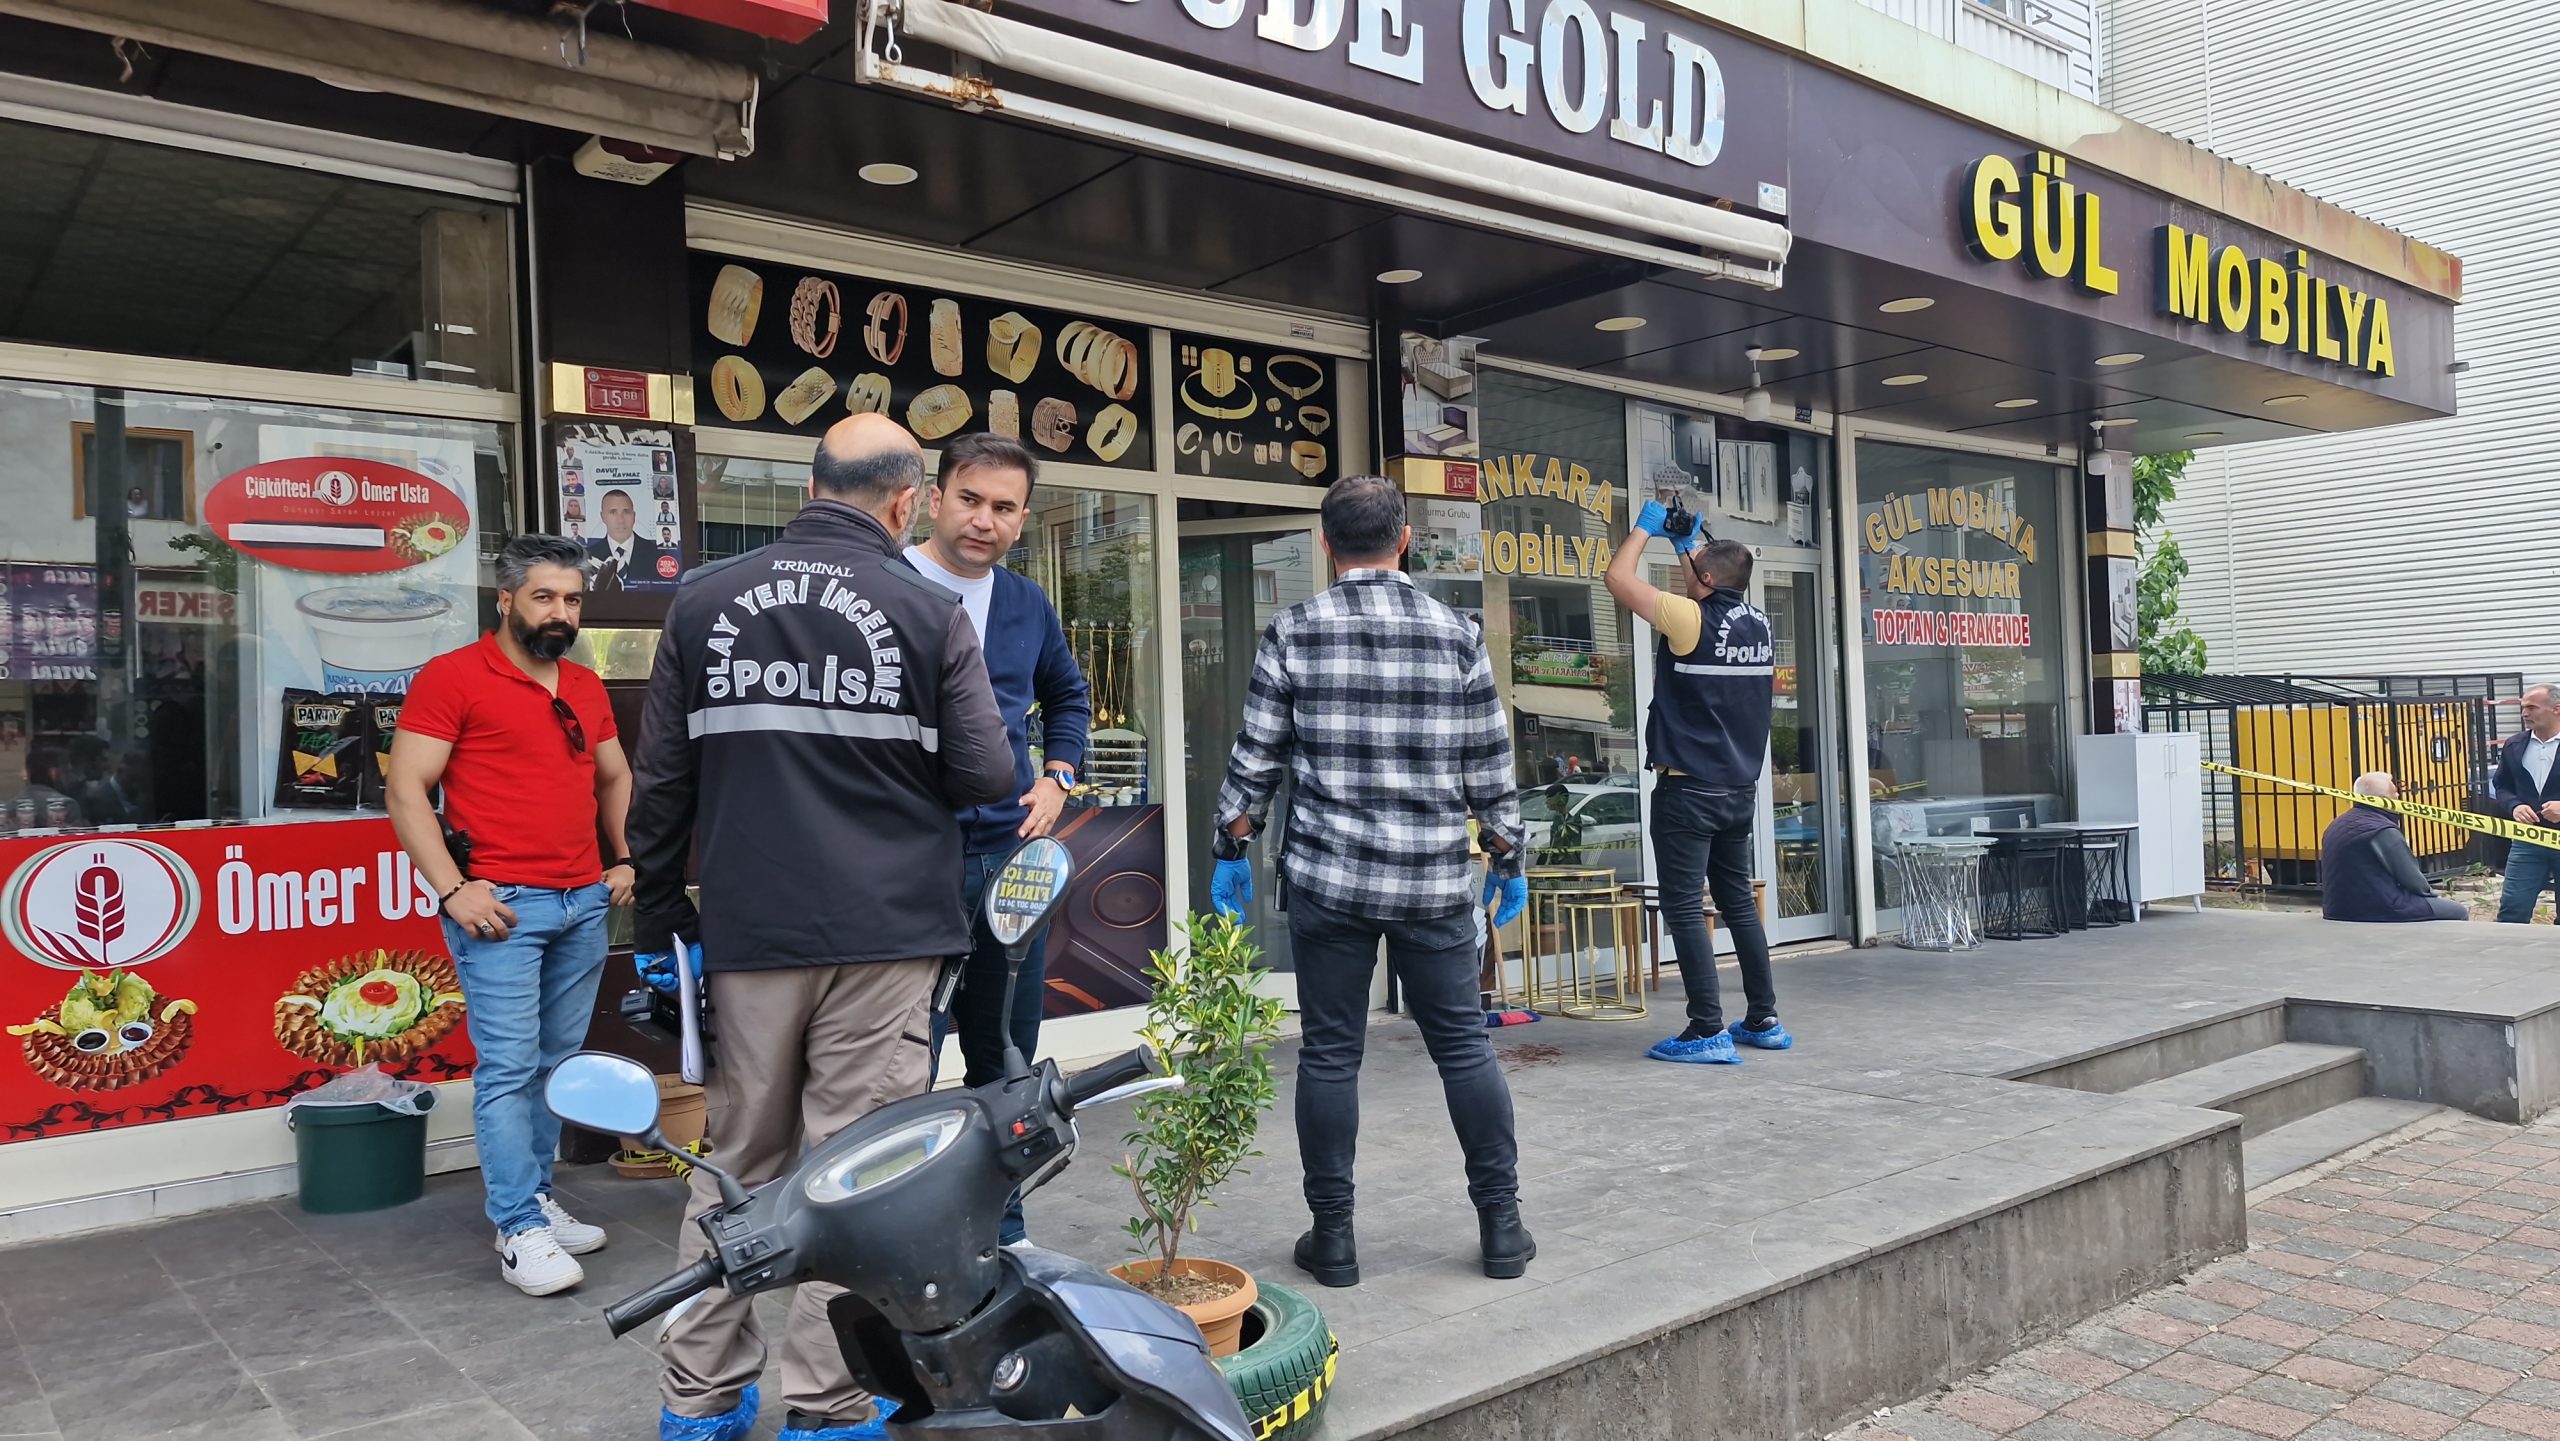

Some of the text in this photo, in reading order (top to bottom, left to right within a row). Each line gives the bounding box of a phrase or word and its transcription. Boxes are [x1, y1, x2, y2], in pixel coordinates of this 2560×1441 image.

[1462, 0, 1727, 167] GOLD
[1966, 150, 2396, 379] GÜL MOBİLYA
[245, 475, 311, 500] Çiğköfteci
[361, 475, 430, 504] Ömer Usta
[1447, 508, 1471, 519] Grubu
[1865, 485, 2035, 565] GÜL MOBİLYA
[1887, 554, 2022, 599] AKSESUAR
[706, 574, 902, 709] OLAY YERİ İNCELEME
[1873, 608, 2031, 647] TOPTAN & PERAKENDE
[1726, 641, 1770, 664] POLİS
[732, 655, 868, 705] POLİS
[297, 705, 343, 725] PARTY
[216, 844, 441, 935] Ömer Us
